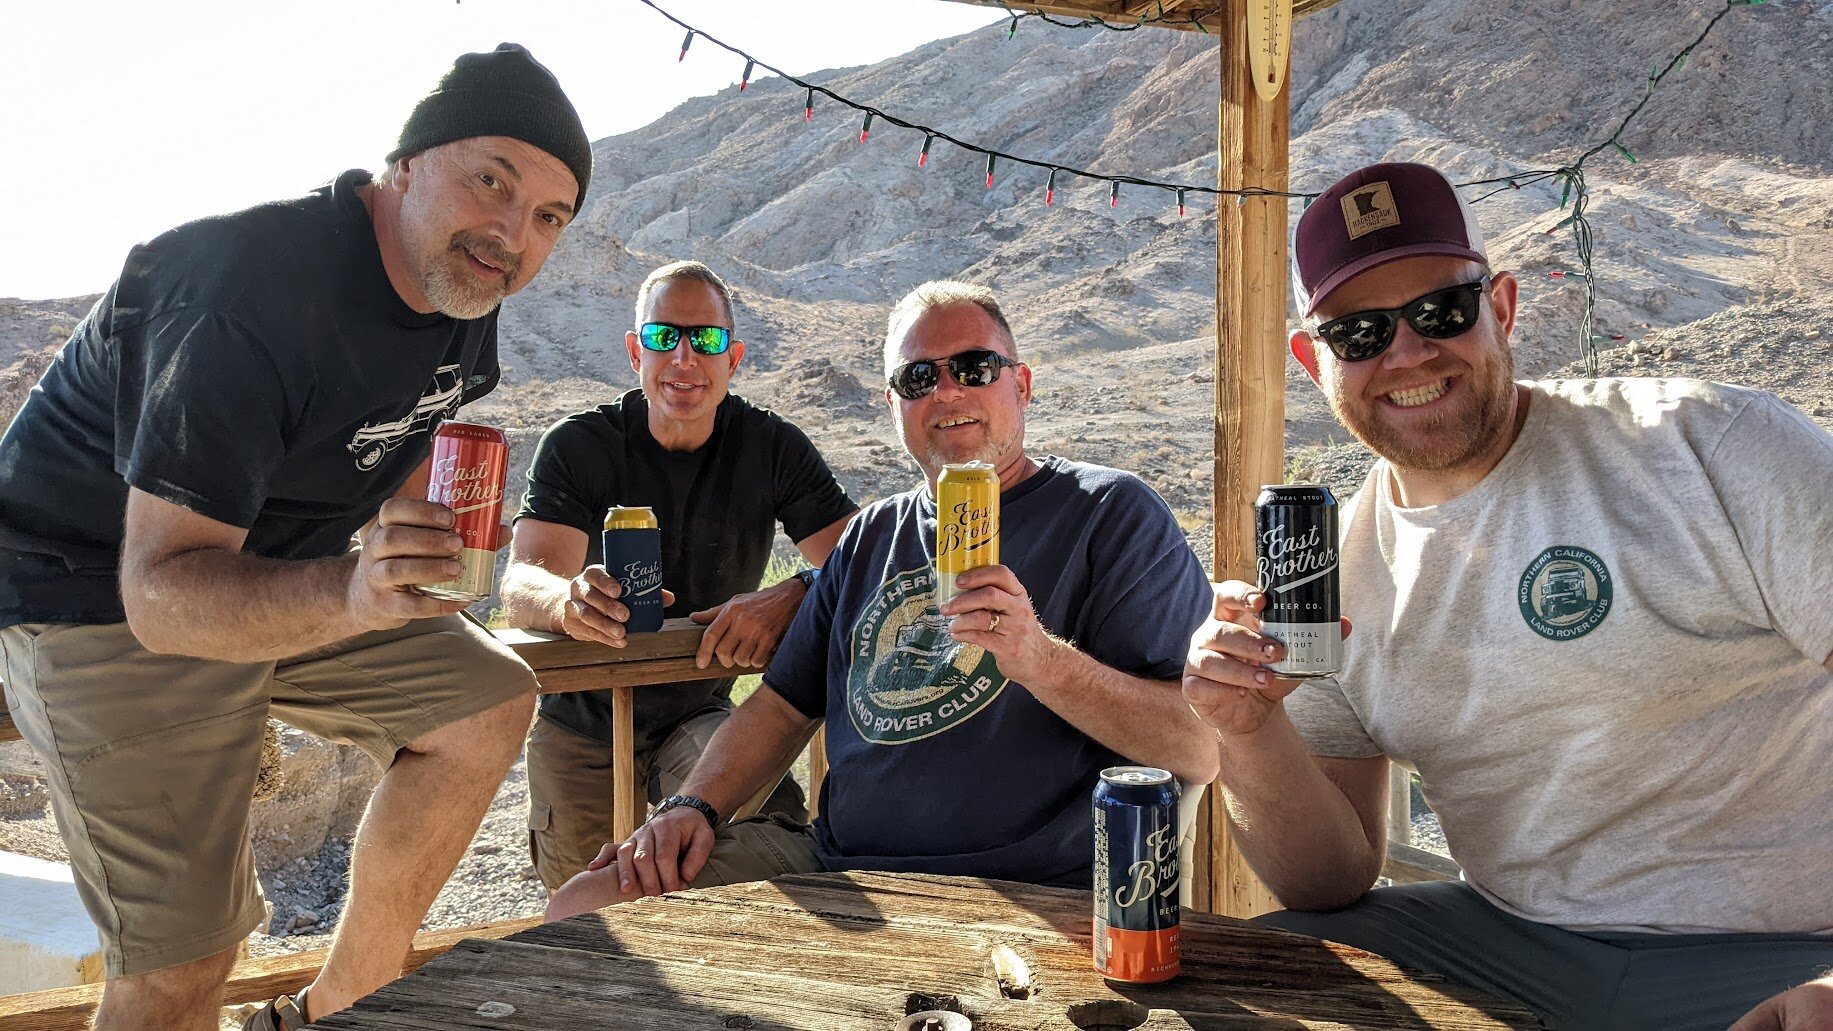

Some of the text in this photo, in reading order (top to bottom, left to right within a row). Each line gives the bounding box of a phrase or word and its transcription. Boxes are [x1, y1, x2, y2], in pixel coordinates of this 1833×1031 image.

[1352, 209, 1392, 229] HACKENSACK
[437, 455, 489, 486] East
[1262, 524, 1320, 560] East
[623, 560, 659, 579] East
[1256, 546, 1339, 594] Brother
[1521, 549, 1607, 604] NORTHERN CALIFORNIA
[859, 571, 937, 657] NORTHERN
[1273, 602, 1323, 610] BEER CO.
[1530, 598, 1608, 638] LAND ROVER CLUB
[853, 675, 993, 732] LAND ROVER CLUB
[1159, 904, 1178, 916] BEER
